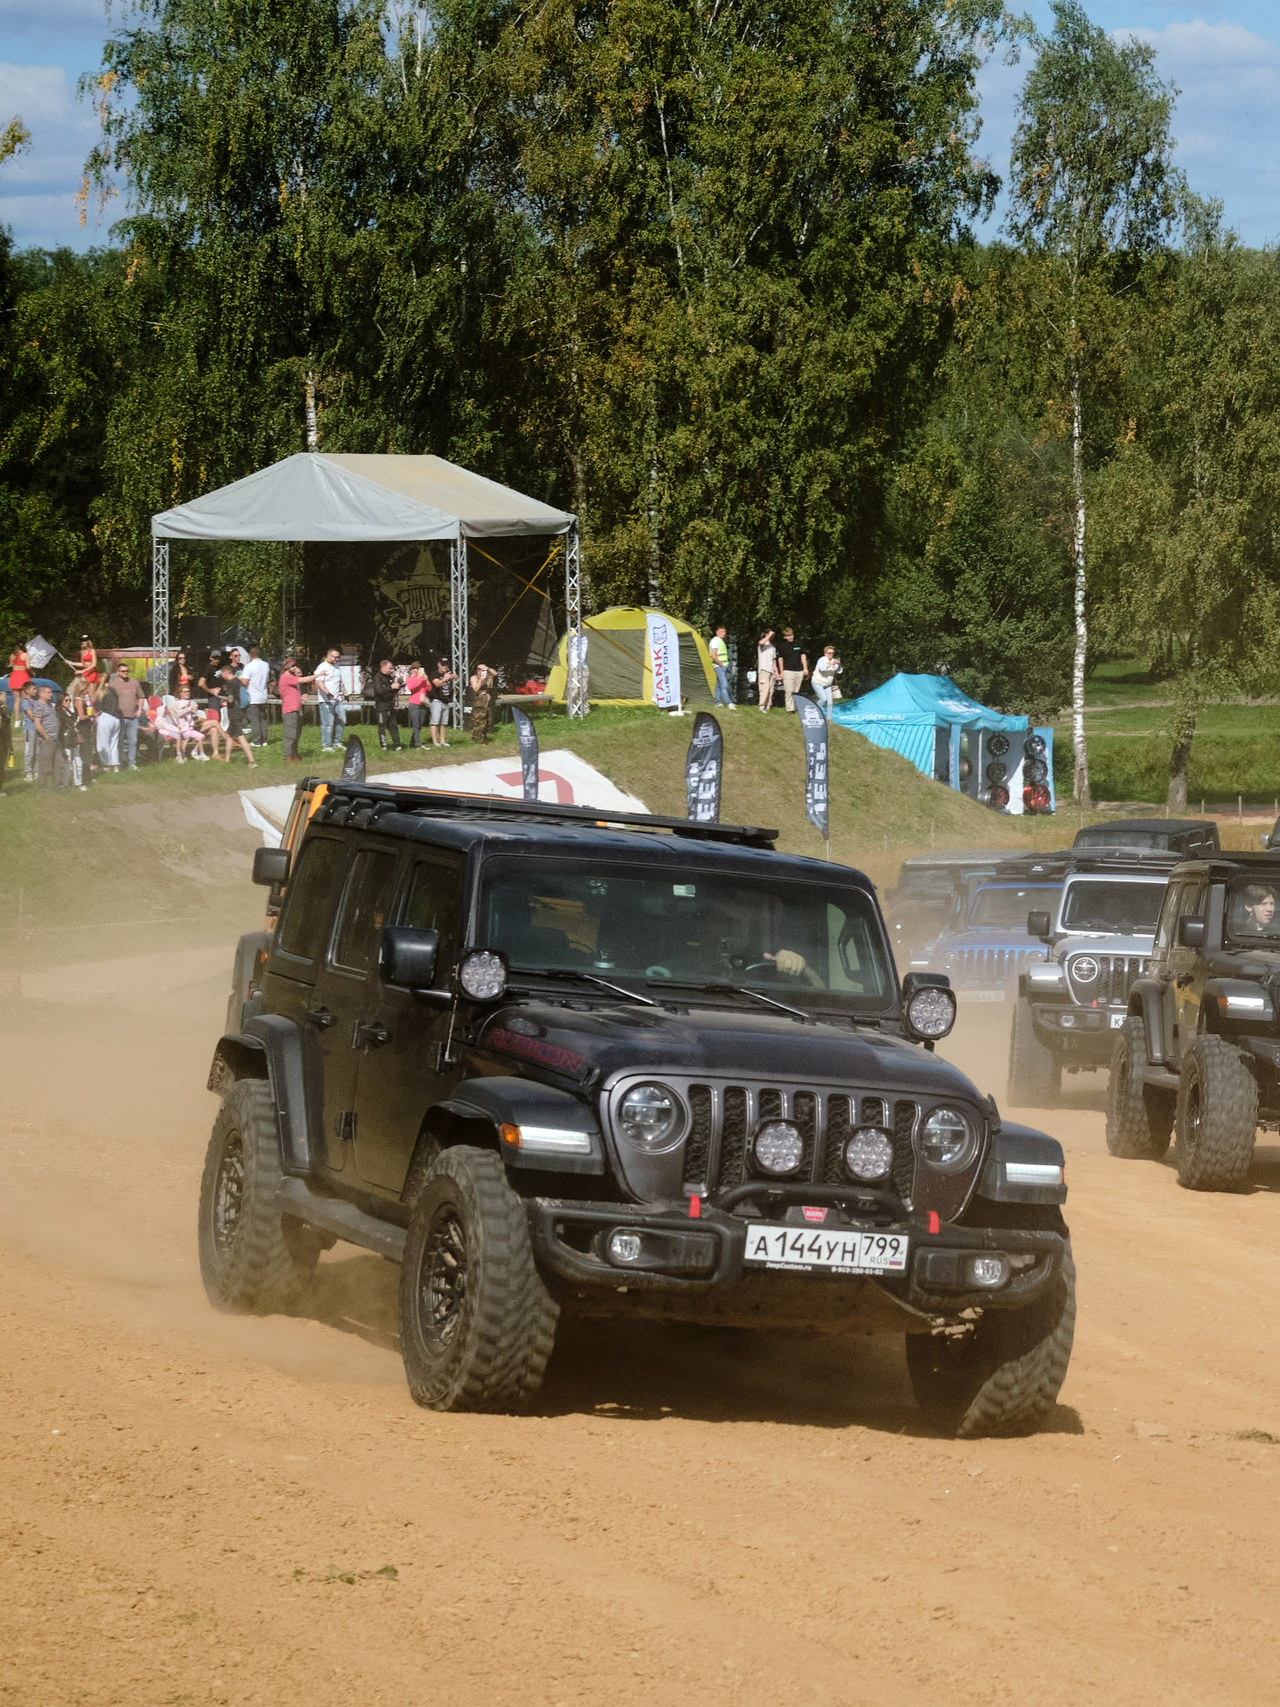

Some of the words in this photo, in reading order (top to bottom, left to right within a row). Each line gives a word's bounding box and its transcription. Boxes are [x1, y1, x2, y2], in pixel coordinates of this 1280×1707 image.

[653, 648, 665, 701] TANK
[663, 645, 671, 704] CUSTOM
[864, 1236, 900, 1257] 799
[869, 1256, 888, 1265] RUS
